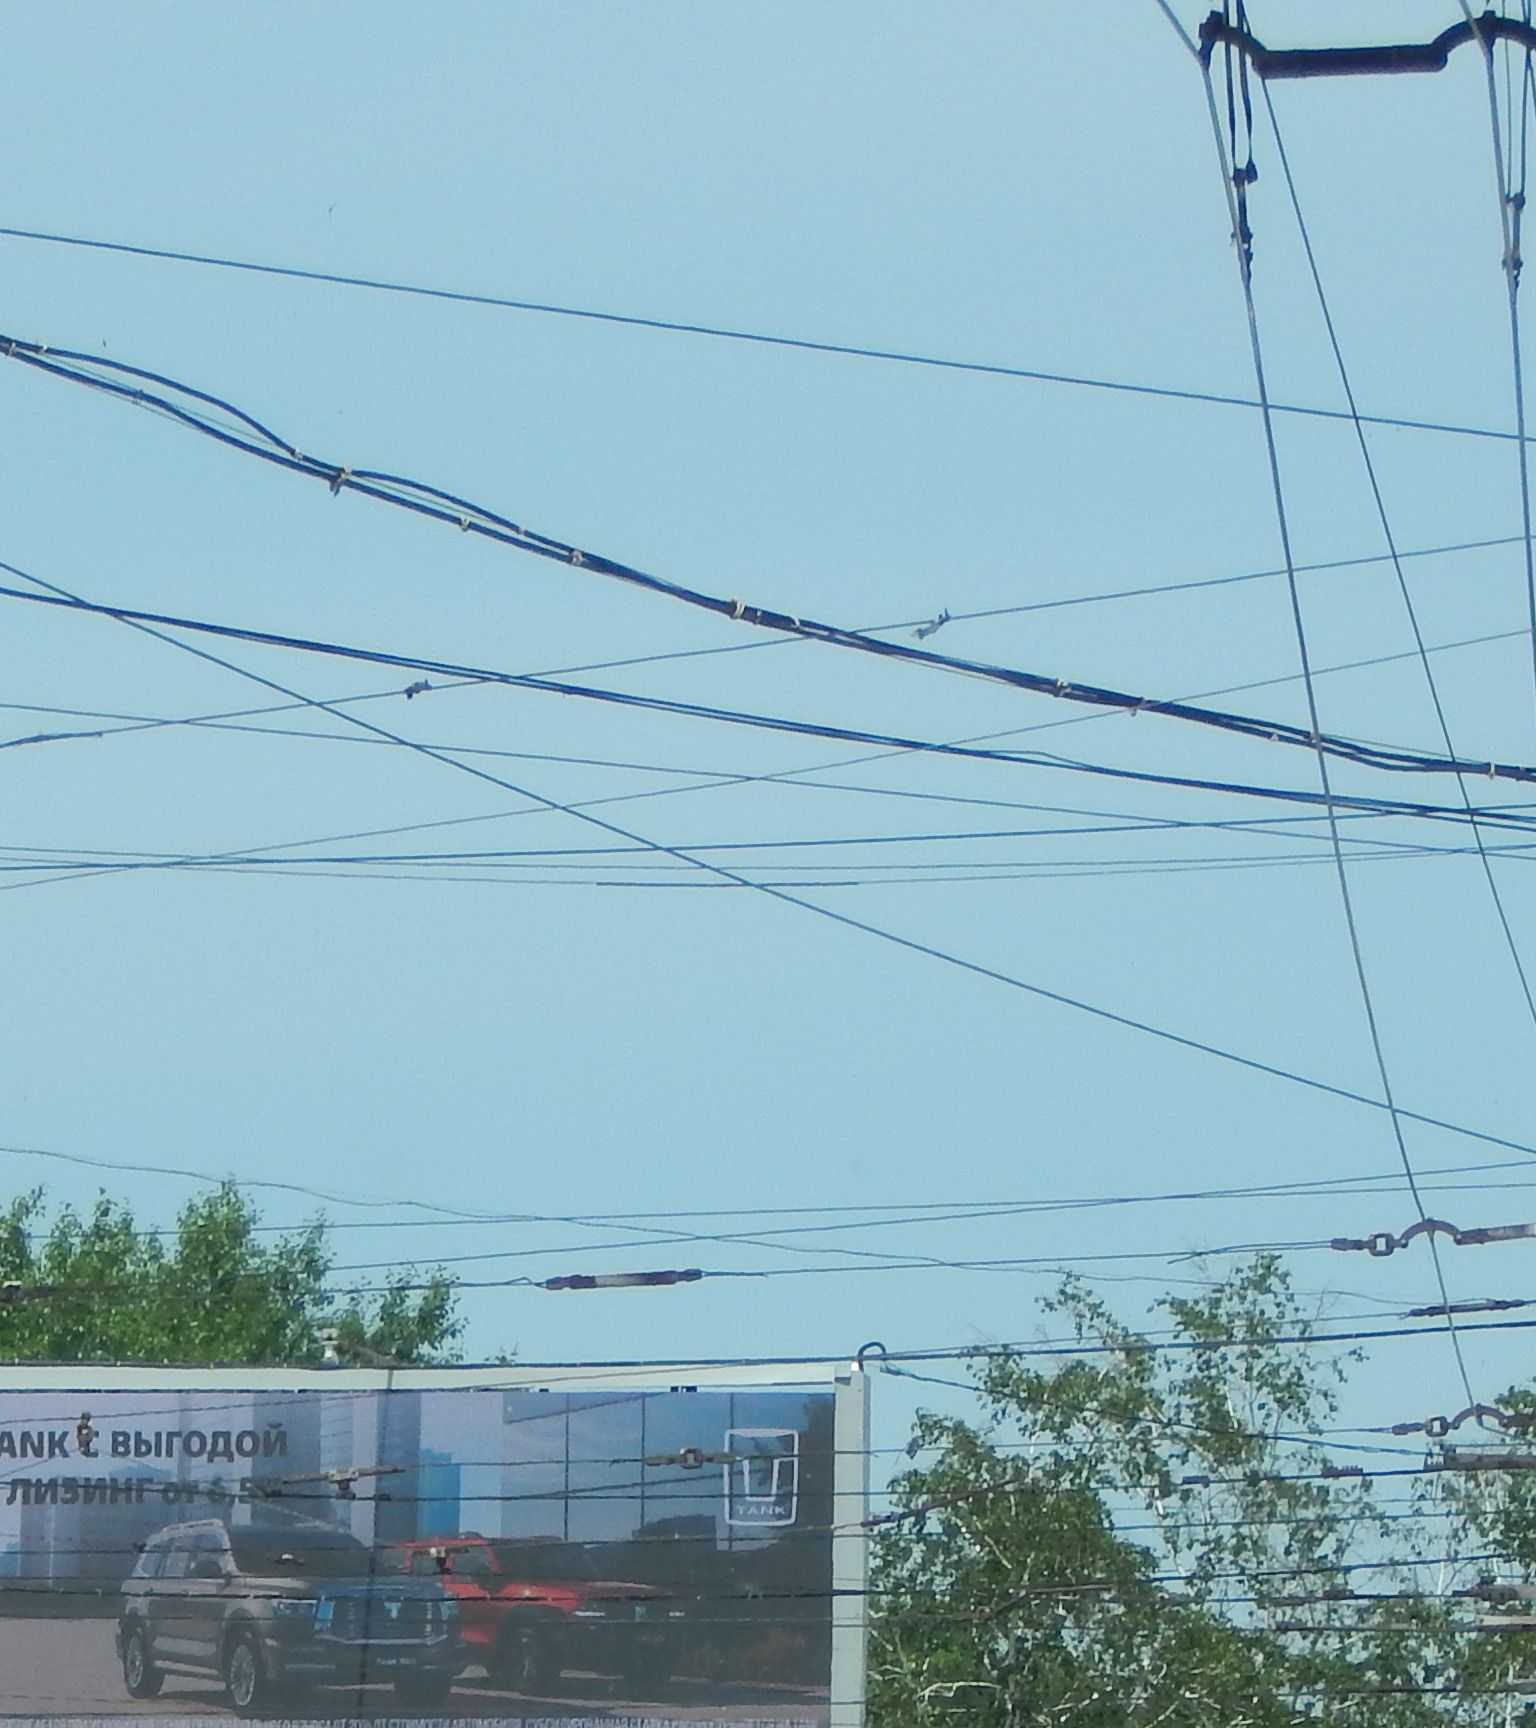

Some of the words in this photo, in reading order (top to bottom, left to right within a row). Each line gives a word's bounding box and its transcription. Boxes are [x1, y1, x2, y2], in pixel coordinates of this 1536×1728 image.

[111, 1424, 287, 1462] ВЫГОДОЙ
[6, 1477, 153, 1505] ЛИЗИНГ
[736, 1504, 785, 1515] TANK
